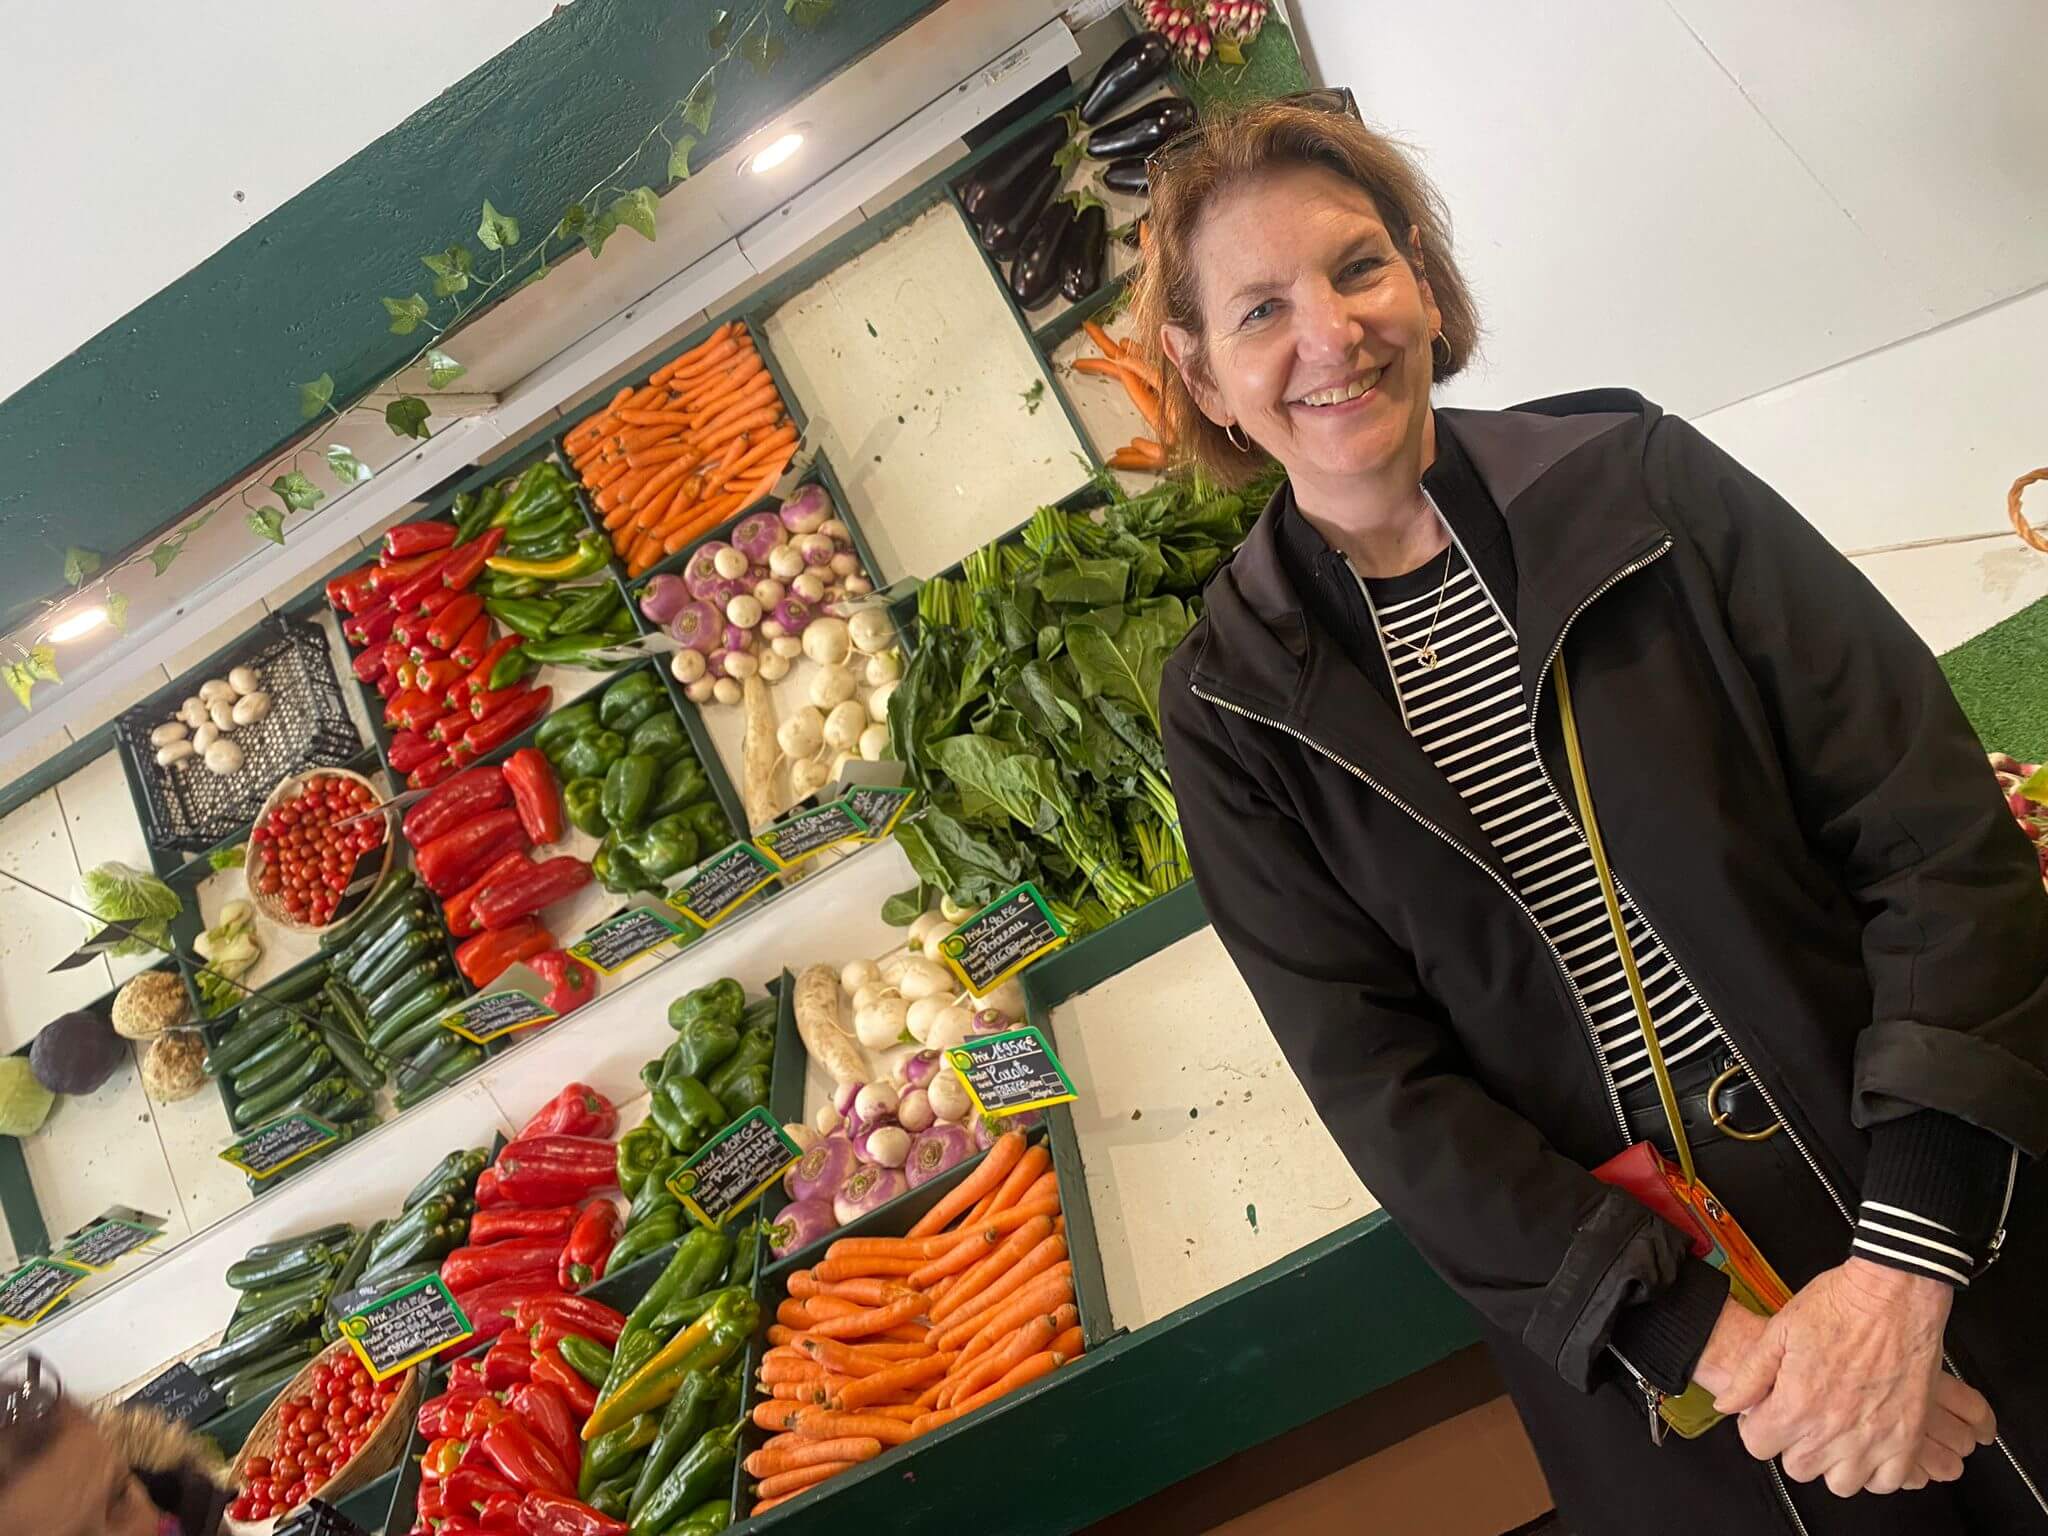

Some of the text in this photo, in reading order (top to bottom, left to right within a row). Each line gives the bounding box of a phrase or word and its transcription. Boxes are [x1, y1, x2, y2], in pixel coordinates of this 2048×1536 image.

[965, 926, 983, 942] Prix
[971, 1051, 989, 1063] Prix
[695, 1159, 716, 1175] Prix
[369, 1311, 388, 1326] Prix
